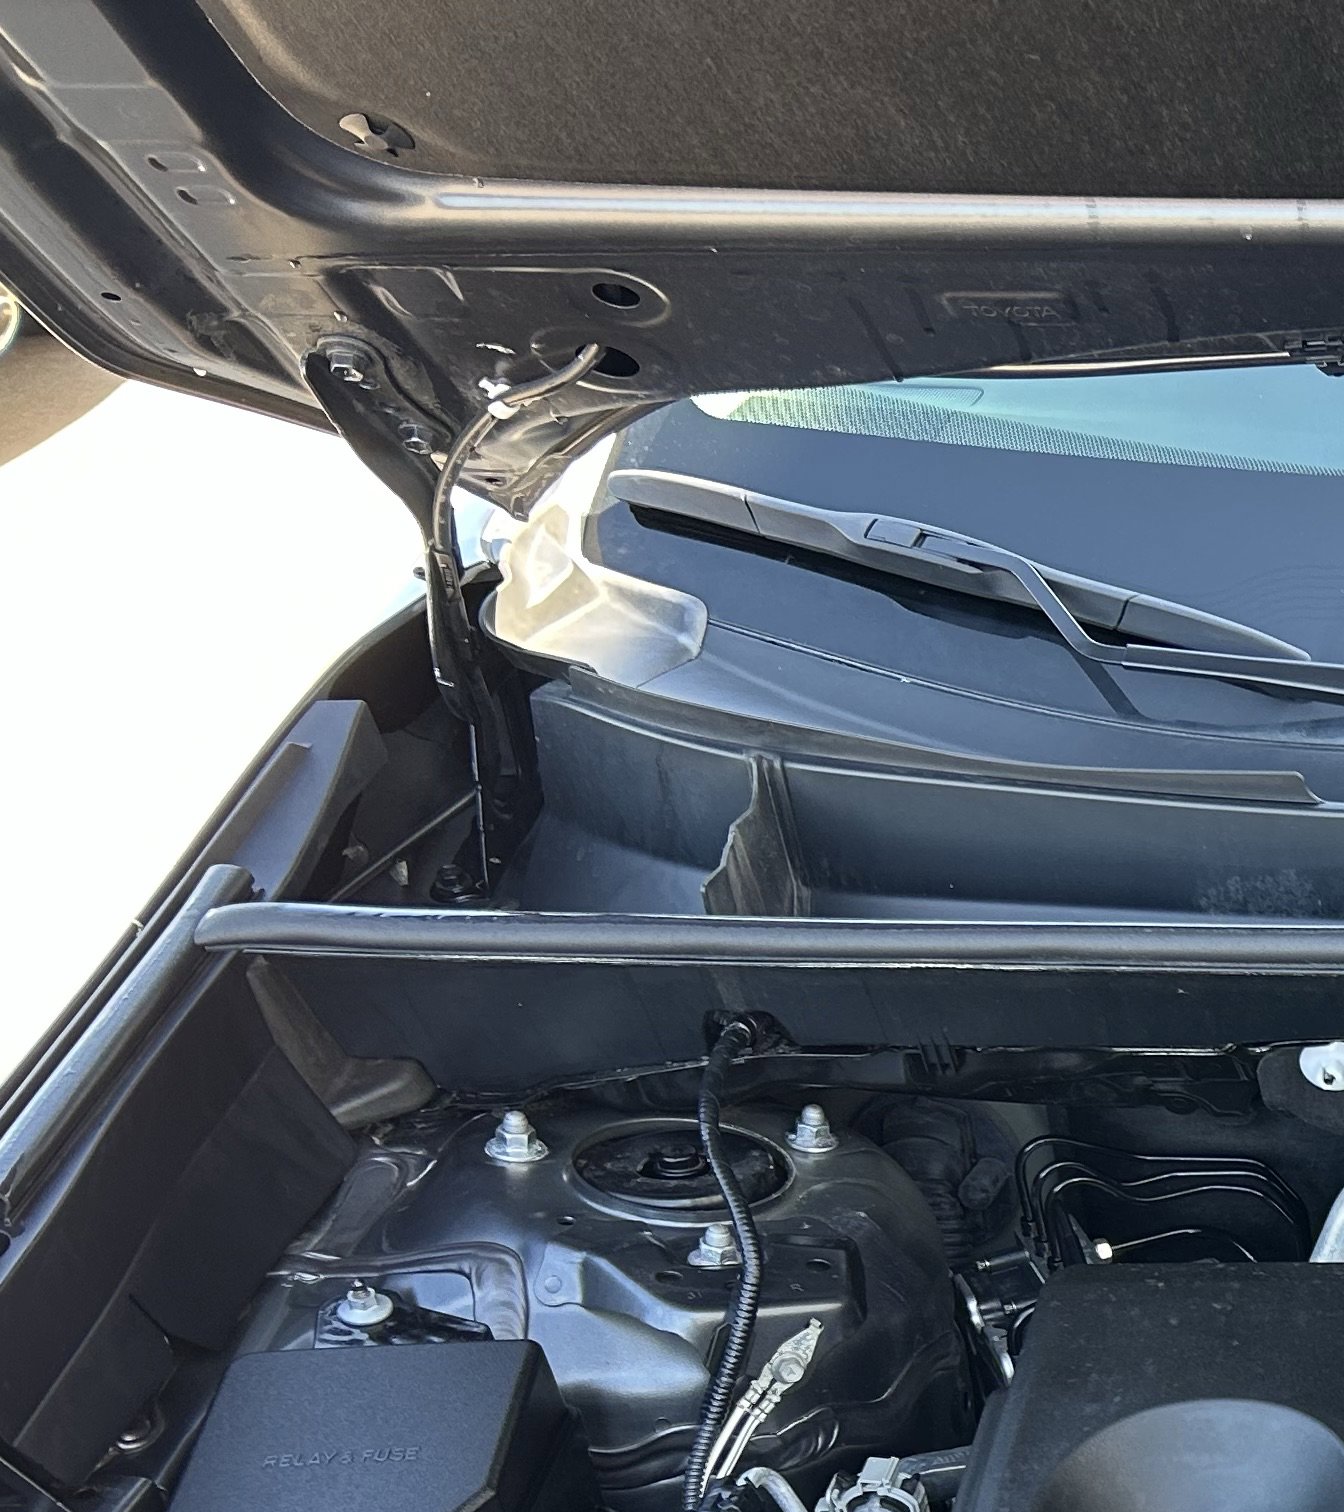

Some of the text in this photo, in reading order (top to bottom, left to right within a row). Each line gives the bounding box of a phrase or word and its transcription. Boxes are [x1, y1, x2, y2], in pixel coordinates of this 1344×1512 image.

[262, 1446, 421, 1468] RELAY & FUSE
